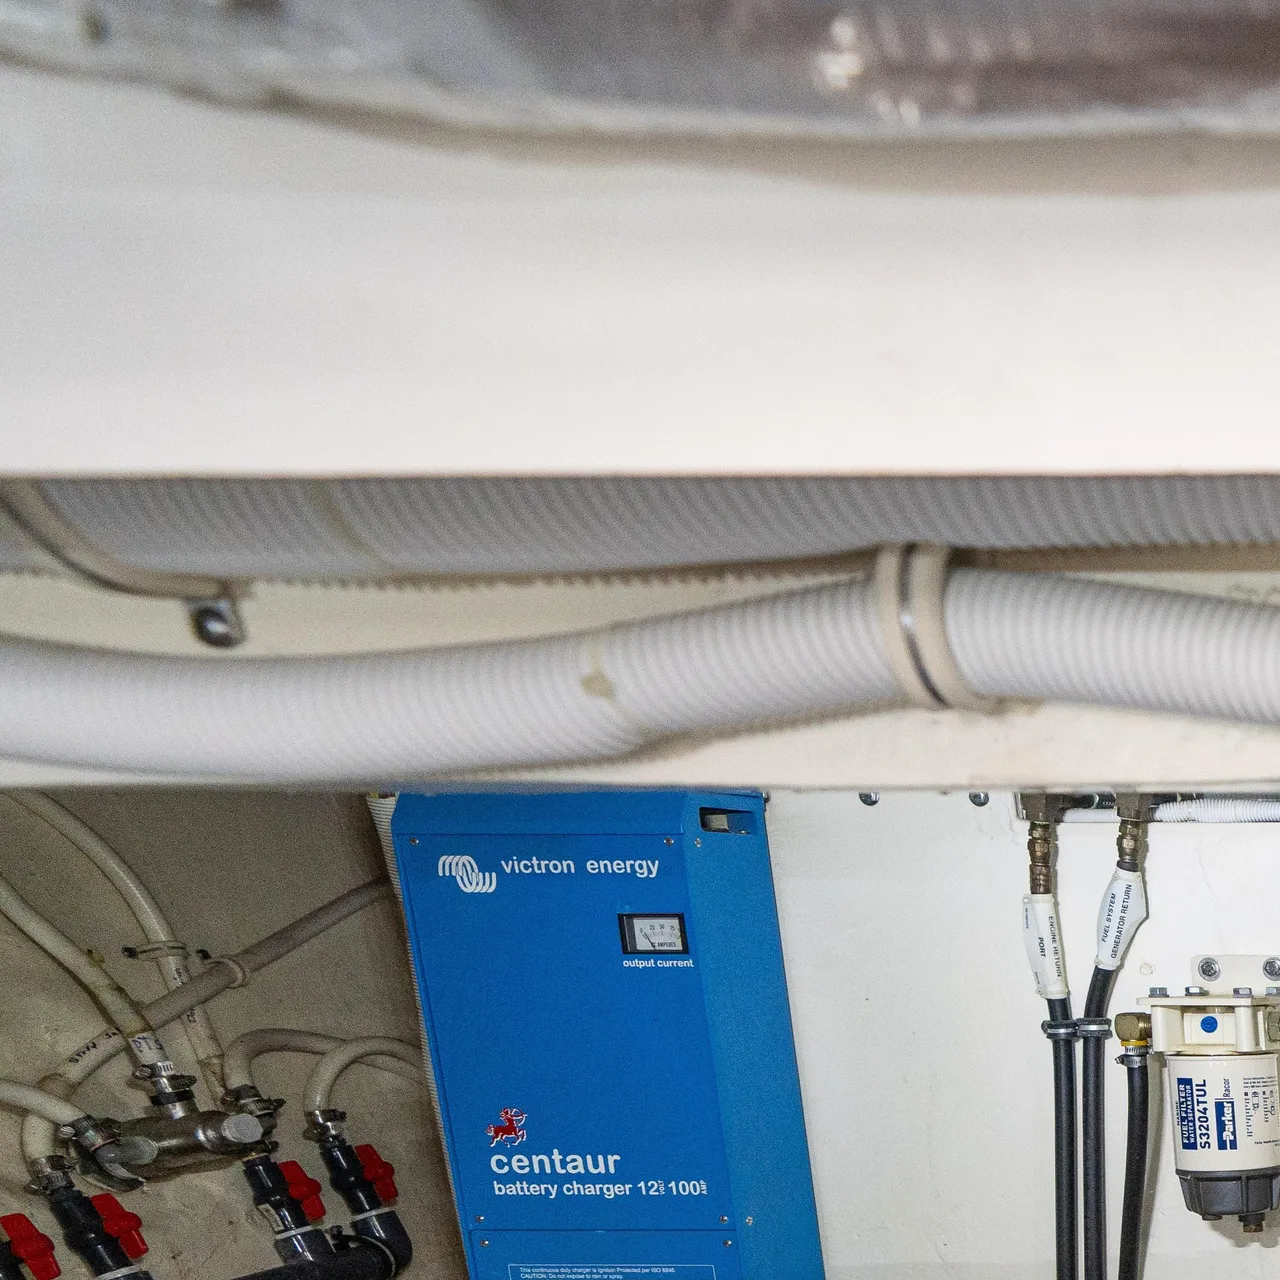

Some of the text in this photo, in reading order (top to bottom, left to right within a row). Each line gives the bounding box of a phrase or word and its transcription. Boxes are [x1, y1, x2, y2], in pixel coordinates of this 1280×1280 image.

[502, 856, 658, 878] victron energy
[1101, 893, 1116, 943] FUEL SYSTEM
[1111, 884, 1132, 959] GENERATOR RETURN
[623, 958, 694, 969] output current
[1195, 1079, 1211, 1149] S3204TUL
[1221, 1078, 1235, 1140] Parker Racor
[490, 1148, 621, 1174] centaur
[494, 1181, 557, 1198] battery
[563, 1181, 632, 1198] charger
[637, 1181, 658, 1195] 12
[668, 1181, 700, 1195] 100
[700, 1180, 708, 1195] AMP
